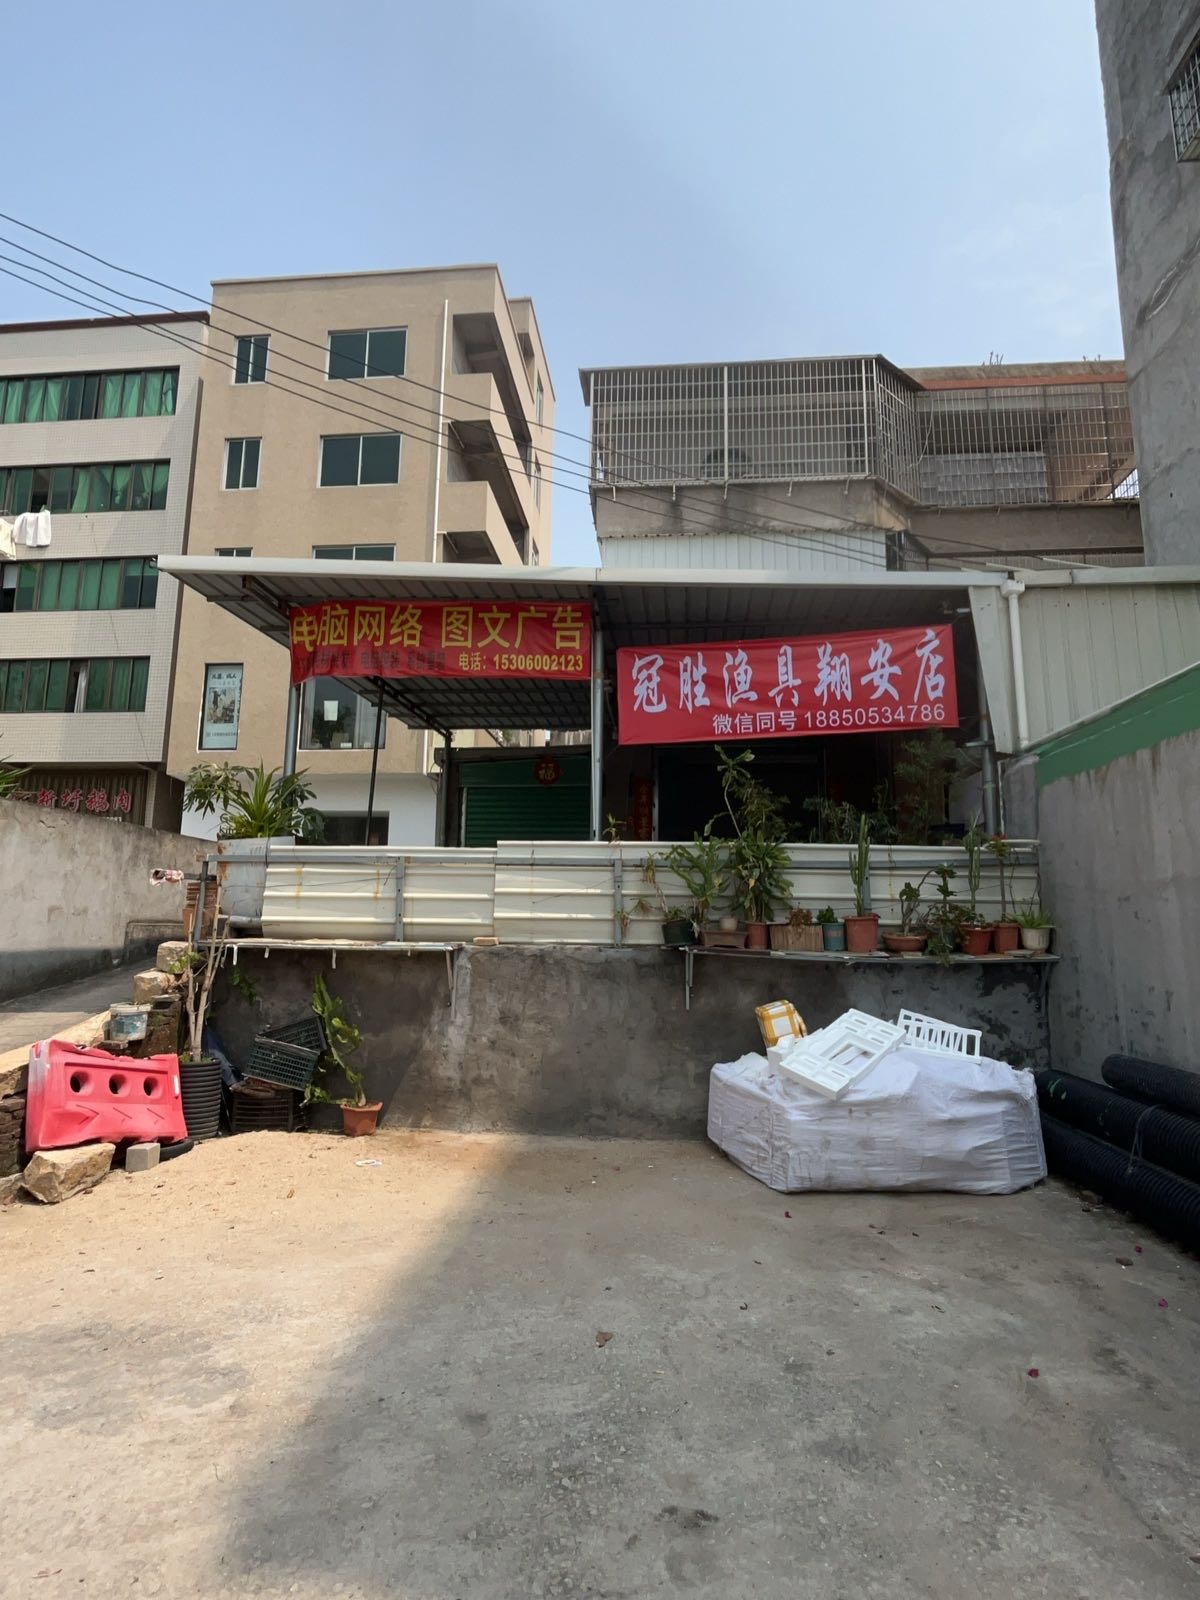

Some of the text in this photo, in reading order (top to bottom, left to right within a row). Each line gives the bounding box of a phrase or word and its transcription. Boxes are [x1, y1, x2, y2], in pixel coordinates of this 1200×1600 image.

[292, 604, 584, 651] 电脑网络 图文广告
[631, 628, 946, 714] 冠胜渔具翔安店
[712, 703, 946, 735] 微信同号 18850534786
[538, 763, 555, 780] 福
